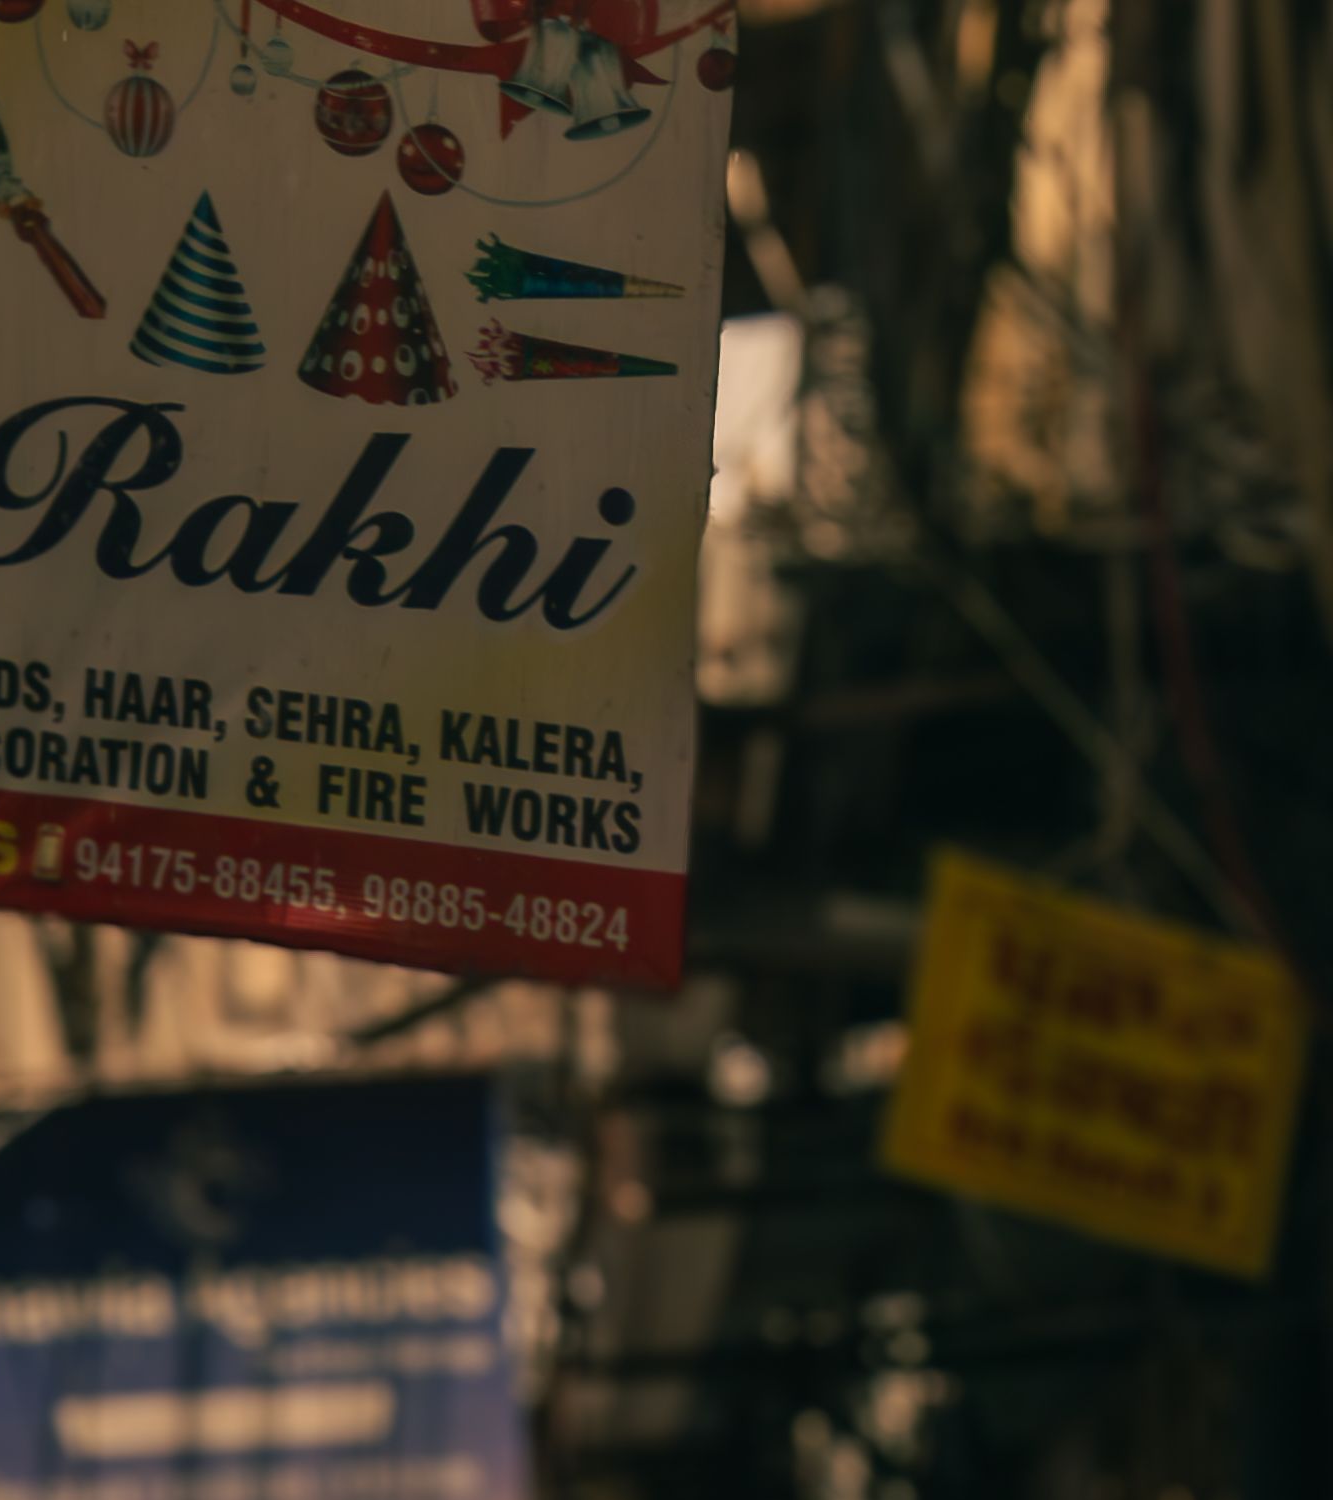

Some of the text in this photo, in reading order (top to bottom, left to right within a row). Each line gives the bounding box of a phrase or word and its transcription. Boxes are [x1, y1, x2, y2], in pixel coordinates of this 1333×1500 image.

[83, 668, 227, 741] HAAR,
[244, 686, 421, 763] SEHRA,
[439, 709, 643, 795] KALERA,
[244, 755, 282, 810] &
[317, 764, 428, 827] FIRE
[463, 781, 641, 856] WORKS
[75, 838, 348, 920] 94175-88455,
[362, 874, 631, 953] 98885-48824
